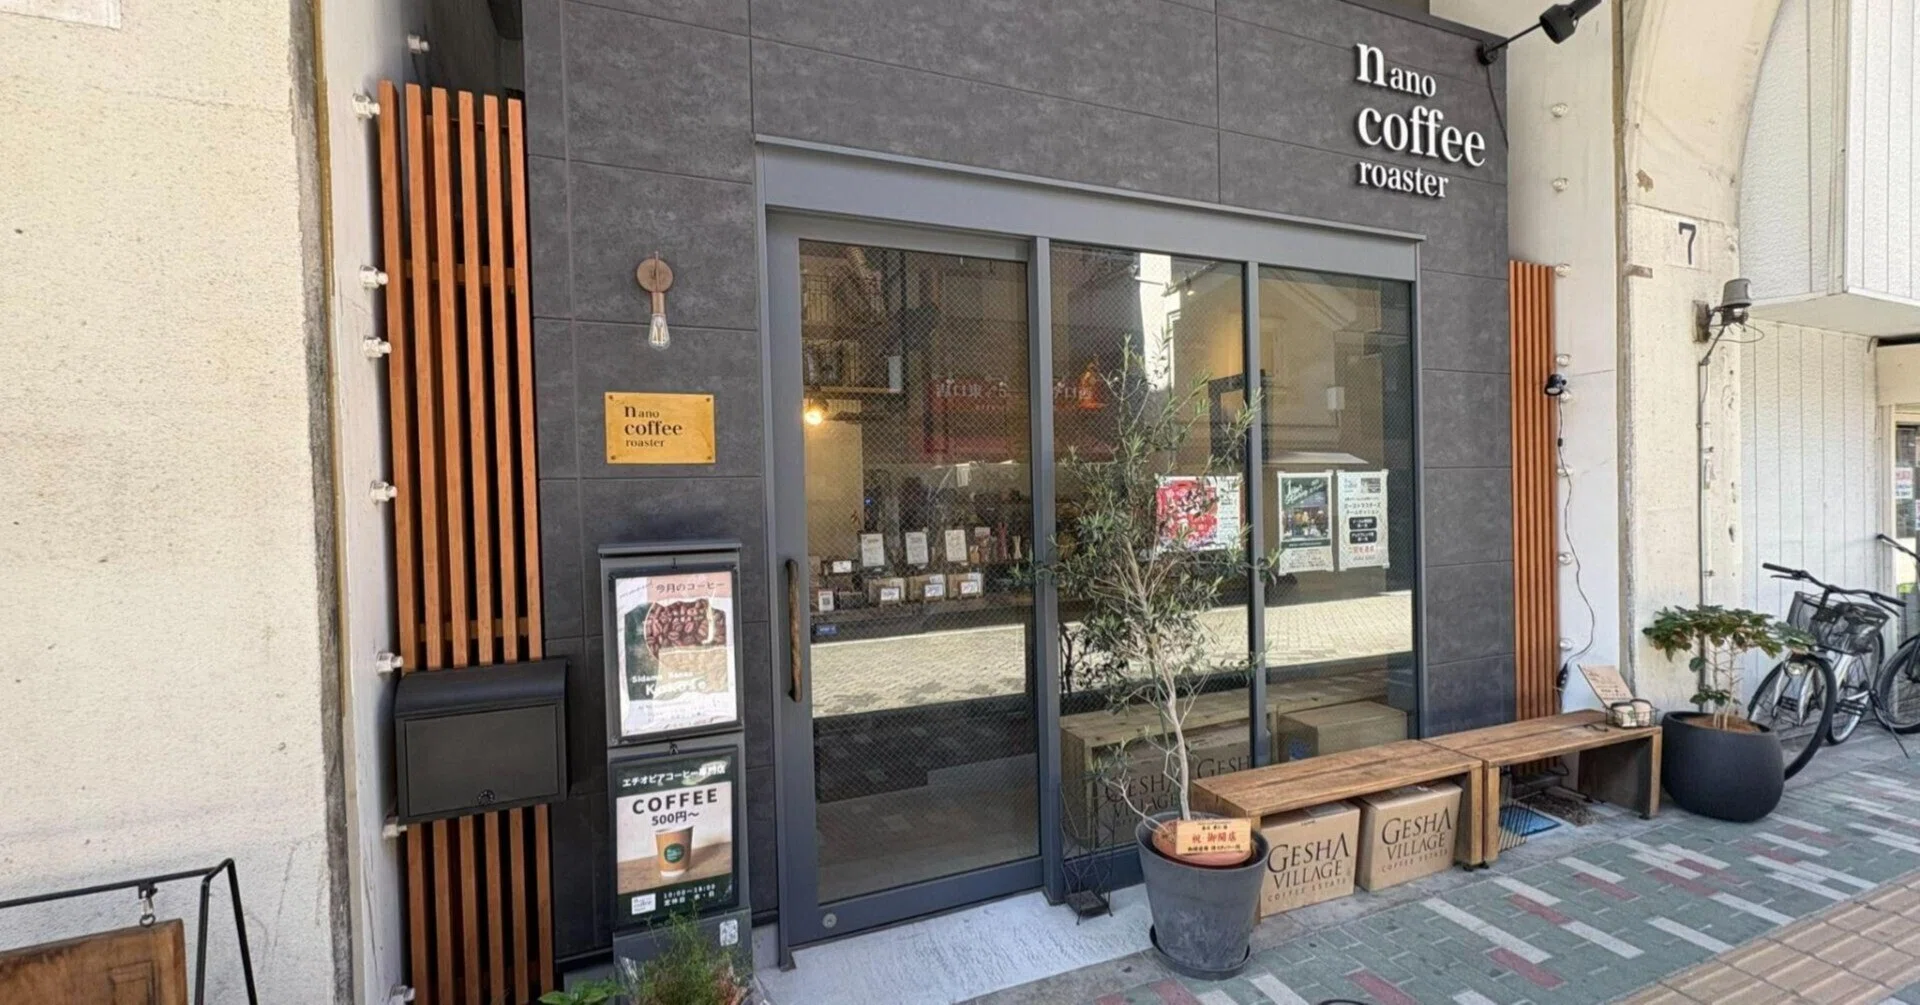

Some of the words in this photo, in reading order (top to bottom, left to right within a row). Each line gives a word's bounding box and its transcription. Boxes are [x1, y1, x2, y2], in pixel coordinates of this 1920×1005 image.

[1356, 43, 1437, 97] nano
[1358, 105, 1486, 167] coffee
[1359, 161, 1449, 198] roaster
[1678, 221, 1697, 265] 7
[624, 406, 660, 418] nano
[624, 420, 683, 436] coffee
[626, 439, 666, 448] roaster
[656, 581, 726, 594] 今月のコーヒー
[622, 764, 726, 787] エチオピアコーヒー専門店
[1197, 755, 1251, 779] GESH
[632, 788, 717, 815] COFFEE
[1382, 806, 1452, 845] GESHA
[1267, 832, 1350, 873] GESHA
[1387, 832, 1445, 860] VILLAGE
[1273, 860, 1342, 890] VILLAGE
[1381, 858, 1413, 873] COFFEE
[1268, 887, 1305, 902] COFFEE
[1312, 878, 1346, 891] ESTATE
